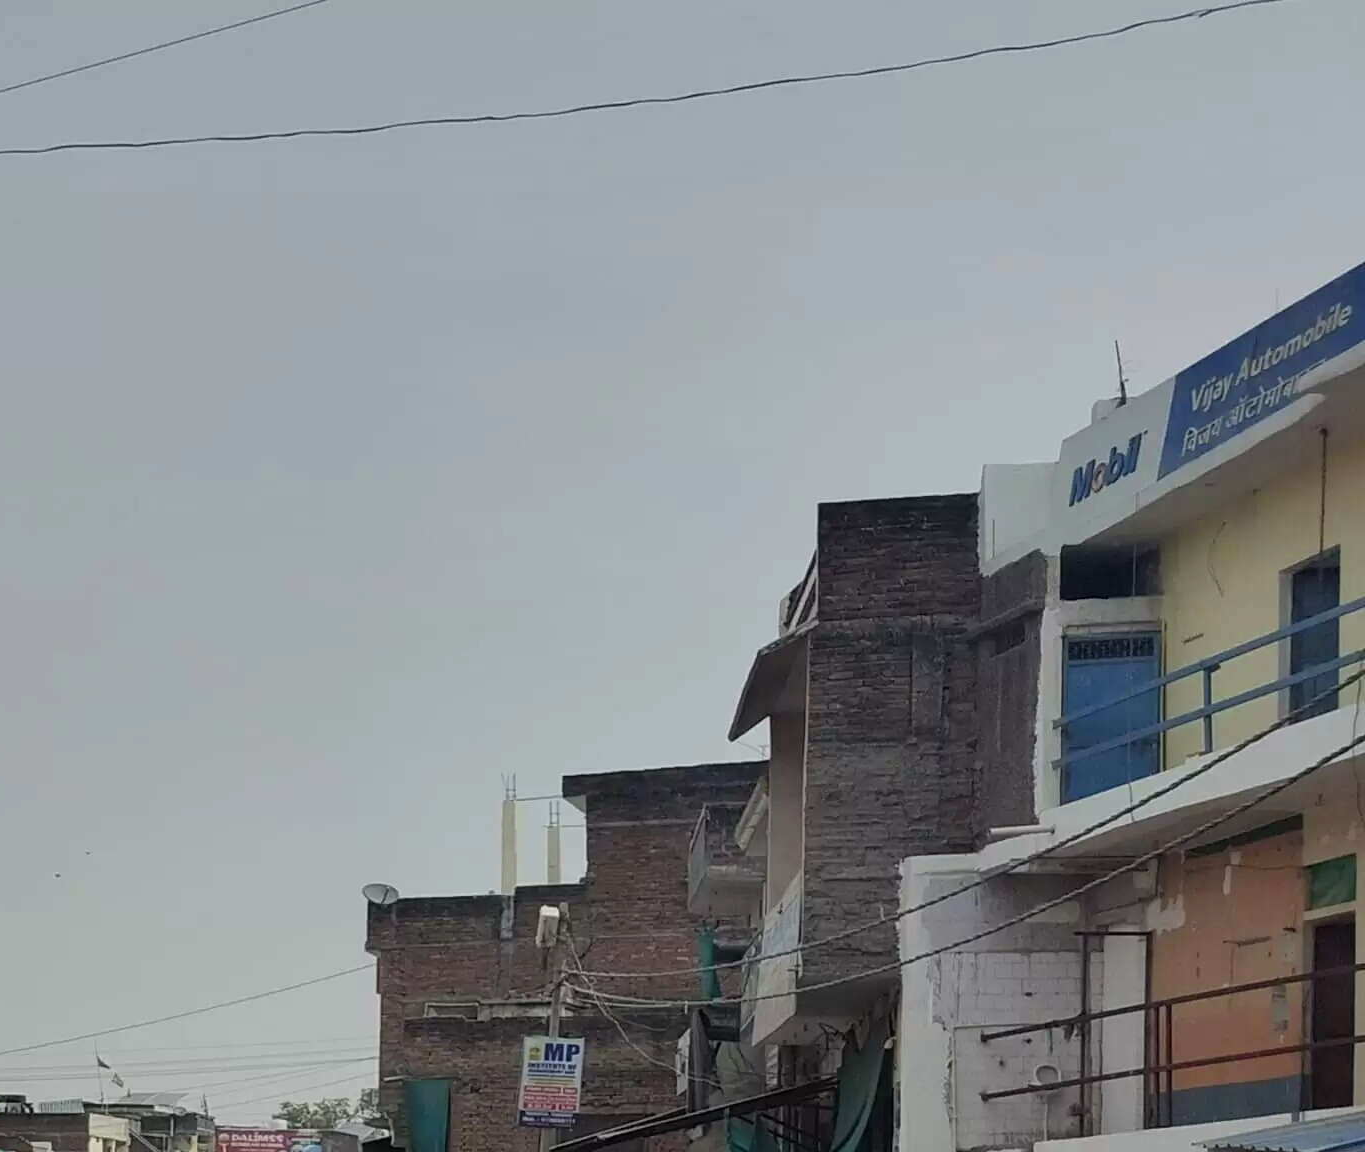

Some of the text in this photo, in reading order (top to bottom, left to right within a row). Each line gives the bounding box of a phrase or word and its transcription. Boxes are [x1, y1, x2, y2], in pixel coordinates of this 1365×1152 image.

[1191, 302, 1353, 413] Vijay Automobile
[1181, 416, 1226, 457] विजय
[1068, 432, 1144, 507] Mobil
[544, 1043, 580, 1062] MP
